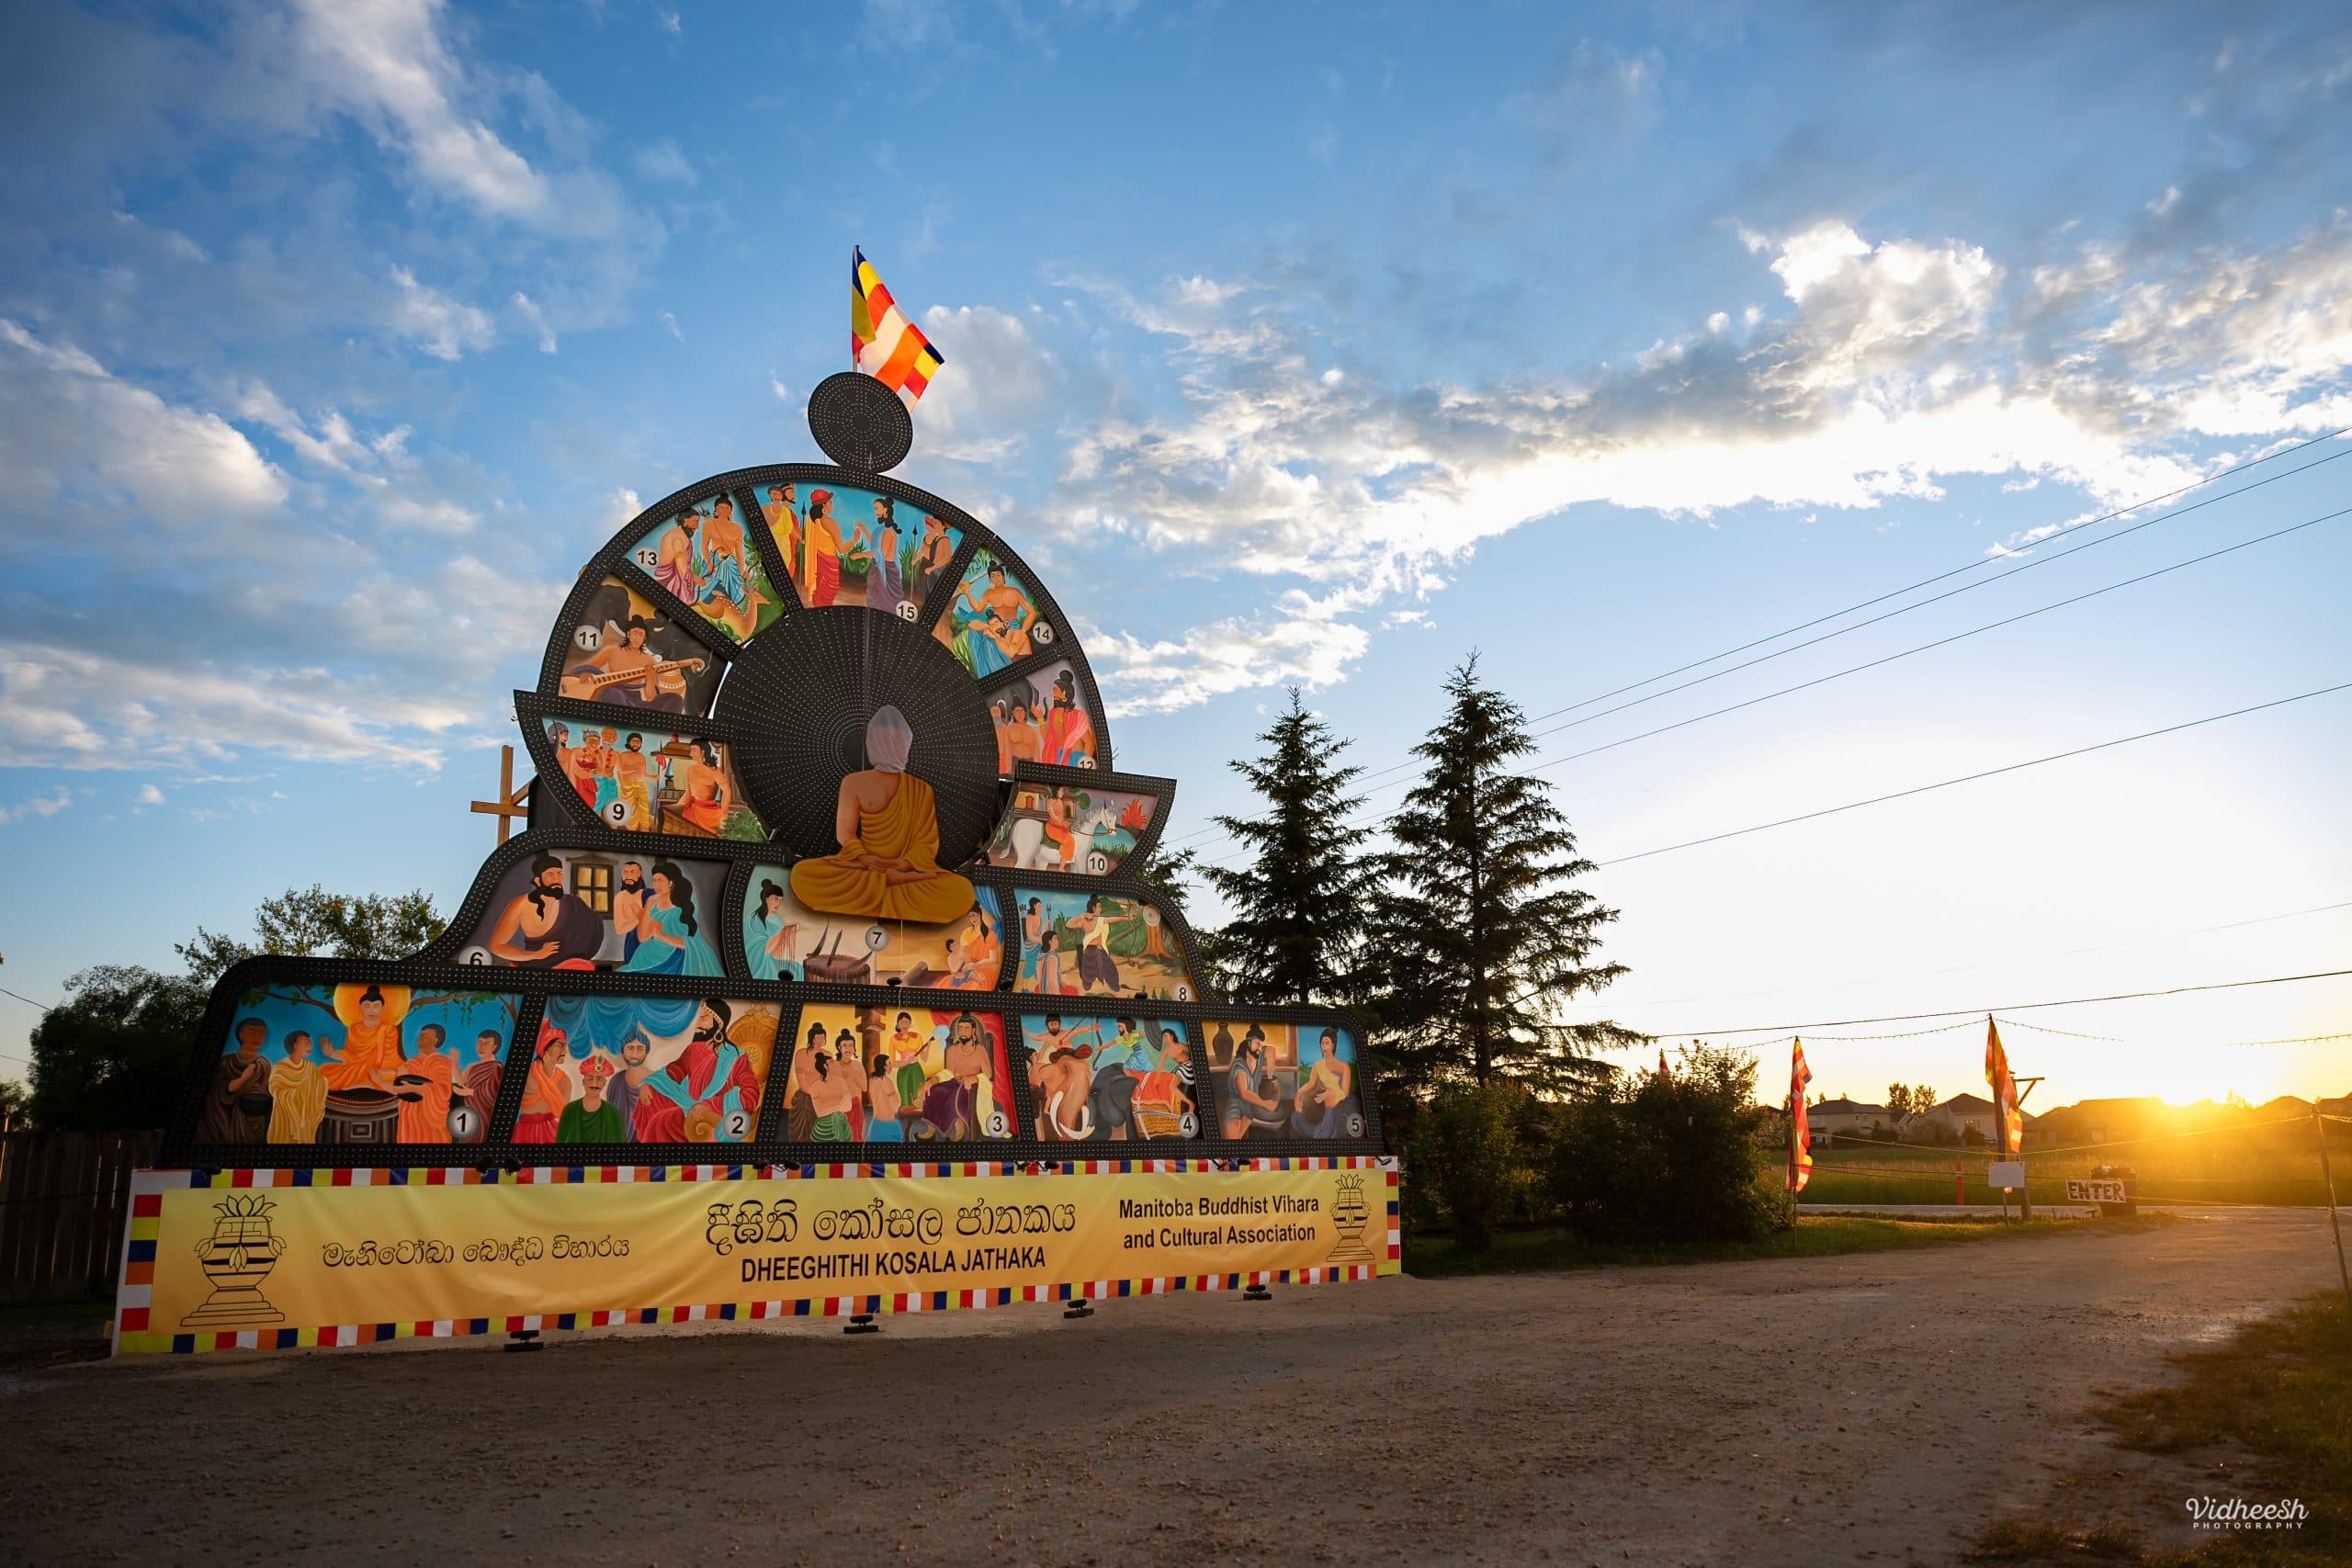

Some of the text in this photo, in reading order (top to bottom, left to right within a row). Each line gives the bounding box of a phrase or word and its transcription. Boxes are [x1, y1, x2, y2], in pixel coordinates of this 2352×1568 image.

[638, 550, 658, 566] 13
[898, 604, 915, 619] 15
[579, 631, 597, 647] 11
[1035, 626, 1050, 640] 14
[1080, 760, 1093, 769] 12
[613, 803, 625, 820] 9
[1090, 856, 1105, 871] 10
[872, 931, 882, 944] 7
[469, 952, 482, 965] 6
[1178, 987, 1187, 1001] 8
[457, 1112, 467, 1132] 1
[730, 1115, 744, 1134] 2
[991, 1115, 1003, 1133] 3
[1182, 1116, 1193, 1132] 4
[1351, 1117, 1360, 1132] 5
[2067, 1181, 2124, 1201] ENTER
[1119, 1195, 1319, 1219] Manitoba Buddhist Vihara
[813, 1197, 943, 1245] කෝසල
[956, 1197, 1076, 1235] ජාතකය
[1124, 1224, 1316, 1249] and Cultural Association
[322, 1239, 454, 1267] මැනිටෝබා
[551, 1235, 630, 1258] විහාරය
[741, 1246, 1046, 1282] DHEEGHITHI KOSALA JATHAKA
